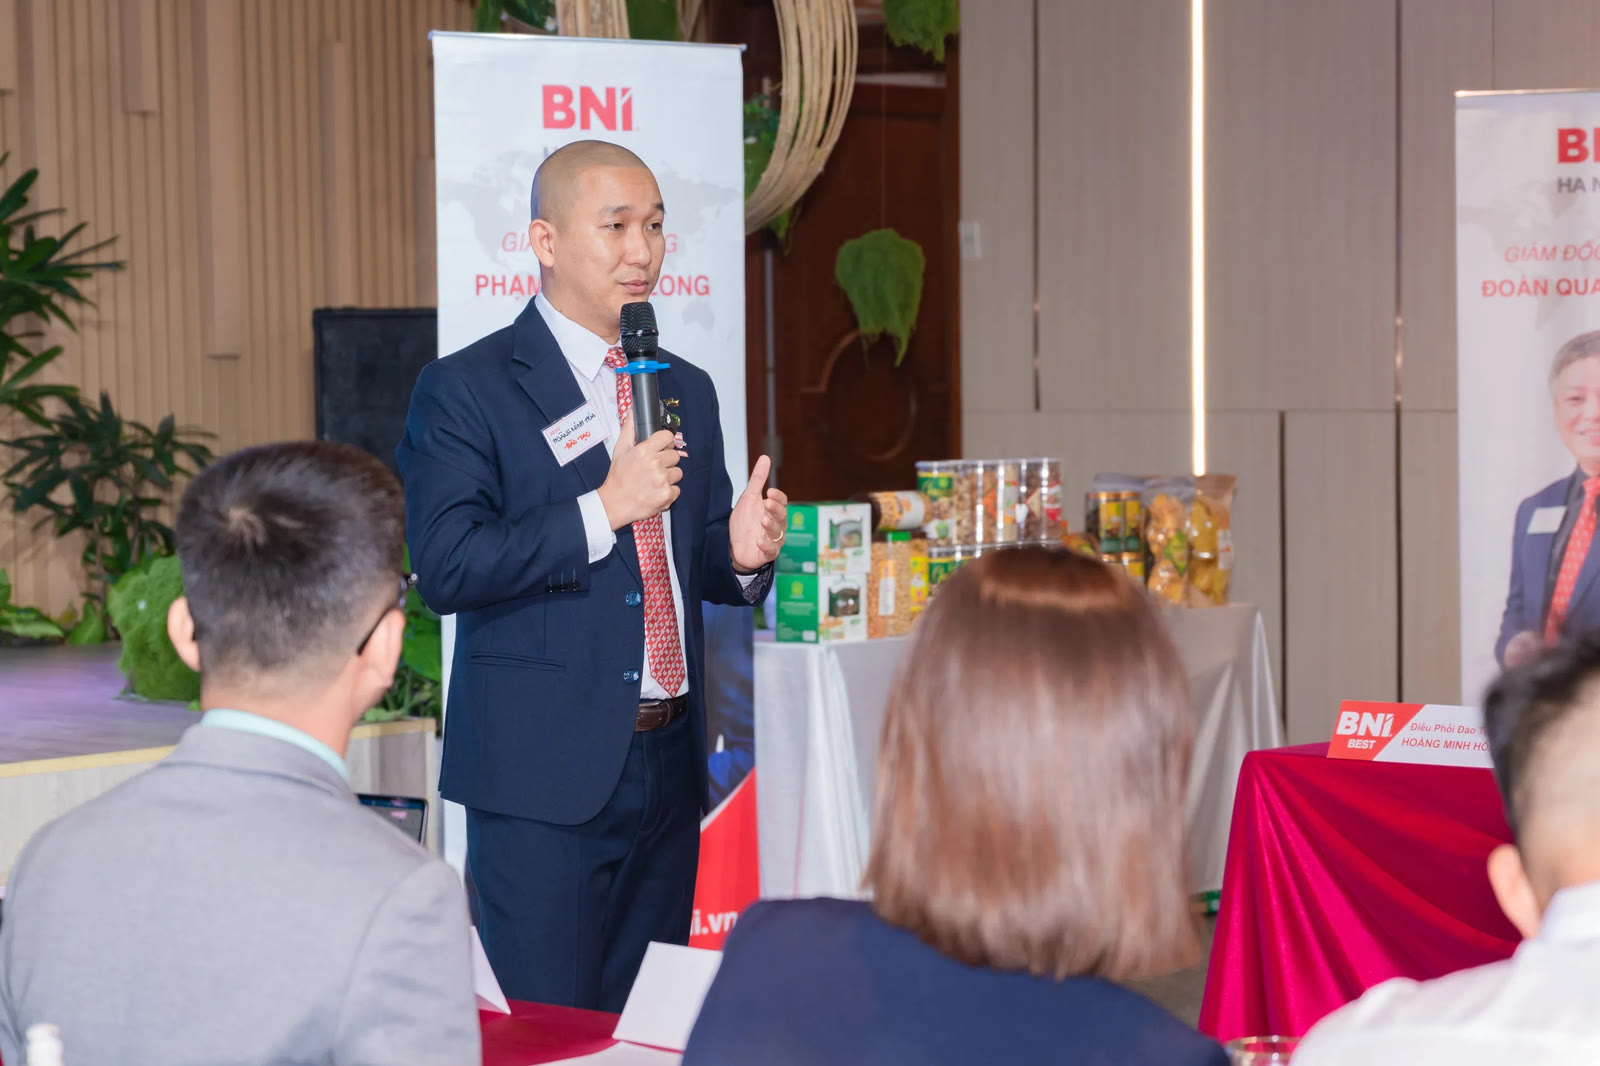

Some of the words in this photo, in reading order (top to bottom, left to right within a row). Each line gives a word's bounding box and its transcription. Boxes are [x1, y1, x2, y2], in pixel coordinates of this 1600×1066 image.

[542, 84, 633, 131] BNI
[1557, 128, 1600, 164] B
[1336, 711, 1394, 737] BNI
[1347, 739, 1376, 749] BEST
[1443, 740, 1471, 750] MINH
[1472, 741, 1489, 752] HÓ
